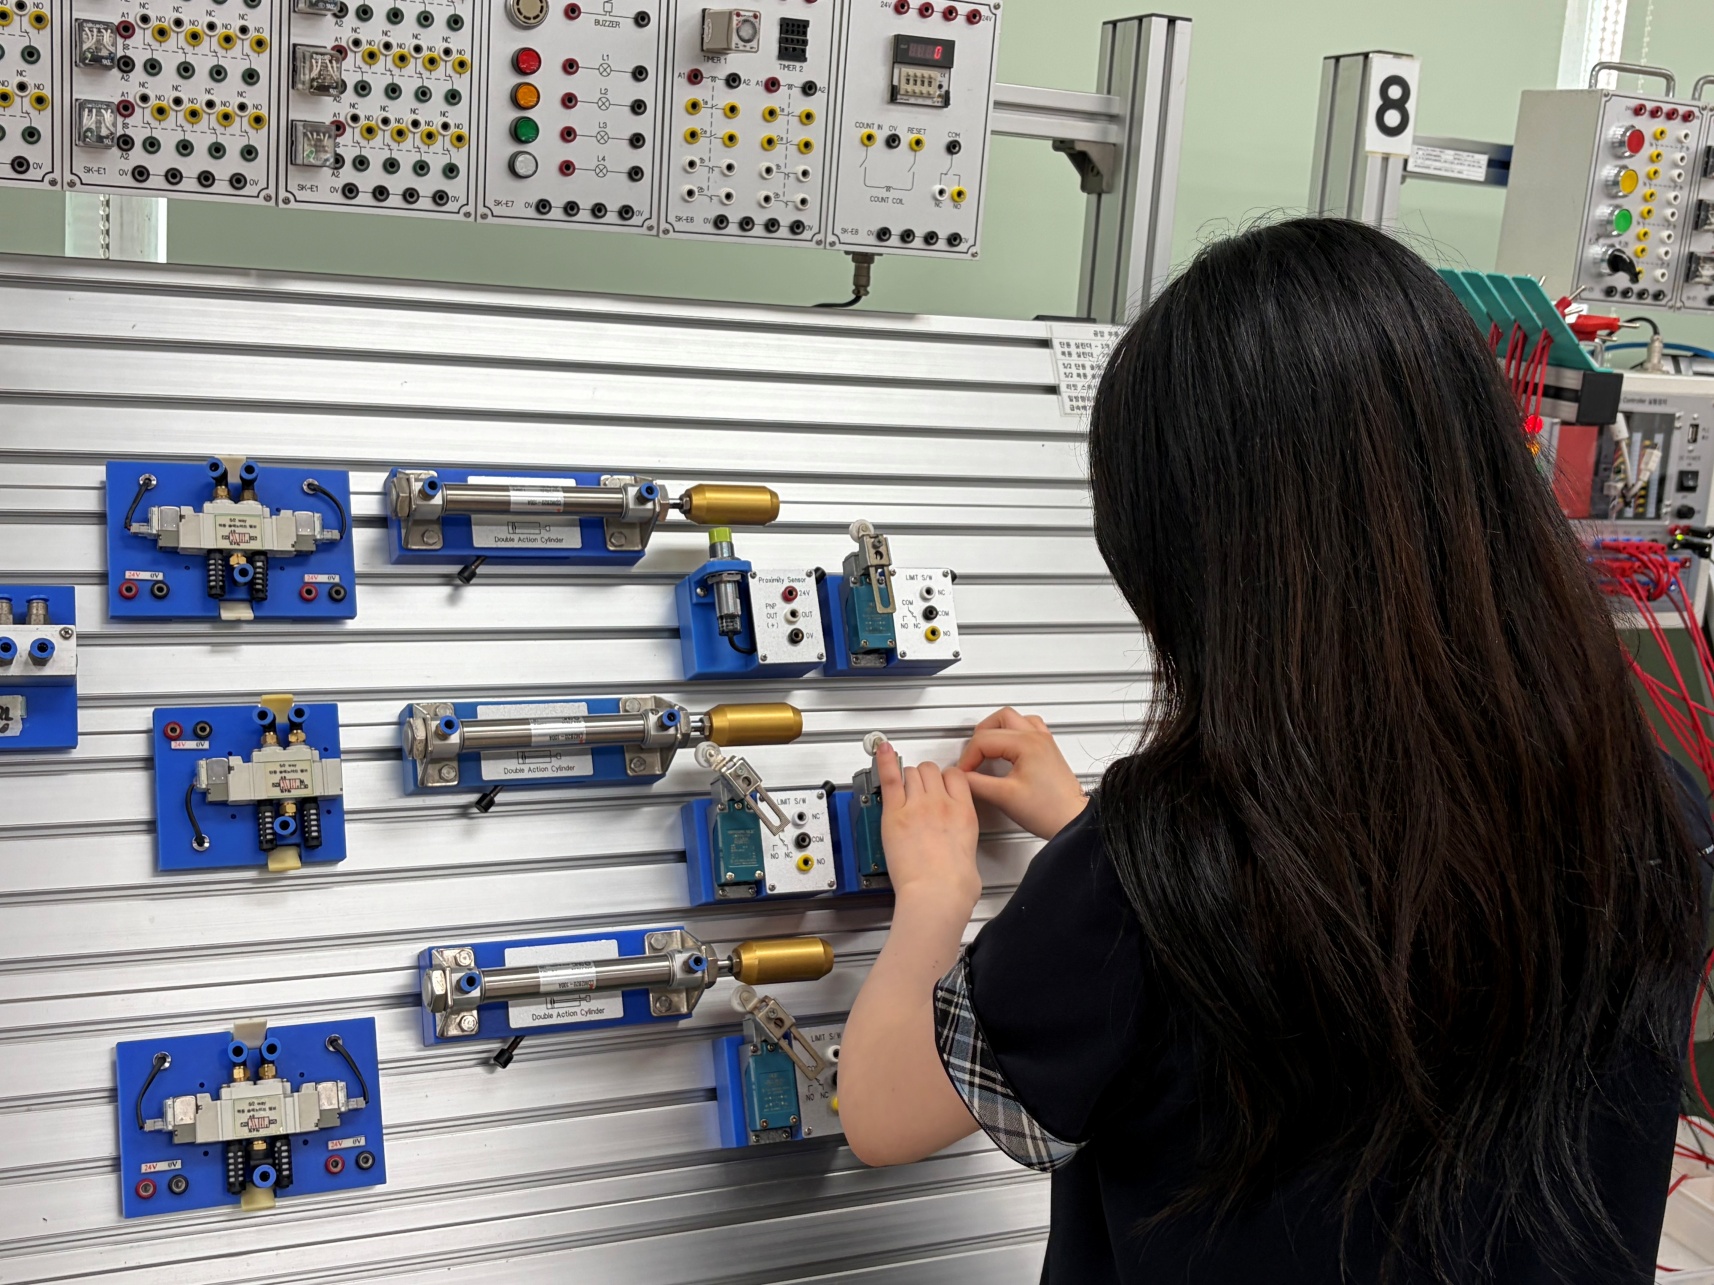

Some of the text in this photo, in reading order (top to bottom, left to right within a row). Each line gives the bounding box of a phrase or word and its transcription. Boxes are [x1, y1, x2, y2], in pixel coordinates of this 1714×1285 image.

[139, 2, 149, 10] NC
[880, 1, 892, 9] 24V
[121, 12, 130, 20] A1
[239, 13, 248, 21] NC
[189, 19, 199, 27] NO
[594, 19, 621, 29] BUZZER
[442, 36, 451, 44] NC
[703, 55, 722, 63] TIMER
[779, 64, 797, 72] TIMER
[16, 69, 27, 77] NC
[139, 81, 149, 89] NC
[742, 78, 751, 86] A2
[34, 83, 45, 91] NO
[121, 91, 129, 99] A1
[155, 94, 165, 102] NO
[350, 102, 359, 110] NC
[380, 105, 389, 113] NC
[1375, 74, 1411, 138] 8
[855, 121, 883, 131] COUNT IN
[907, 127, 927, 135] RESET
[947, 131, 961, 139] COM
[597, 155, 606, 163] L4
[83, 166, 107, 175] SK-E1
[331, 170, 341, 178] A2
[297, 183, 319, 193] SK-E1
[493, 199, 515, 208] SK-E7
[869, 195, 905, 206] COUNT COIL
[953, 202, 962, 210] NO
[494, 535, 564, 546] Double Action Cylinder
[127, 571, 141, 579] 24V
[305, 574, 319, 582] 24V
[905, 574, 933, 582] LIMIT S/W
[758, 576, 807, 586] Proximity Sensor
[799, 589, 811, 597] 24V
[765, 602, 777, 610] PNP
[766, 612, 778, 620] OUT
[801, 611, 813, 619] OUT
[938, 610, 950, 618] COM
[900, 622, 909, 630] NO
[913, 622, 921, 630] NC
[503, 763, 576, 775] Double Action Cylinder
[776, 797, 807, 806] LIMIT S/W
[811, 835, 824, 843] COM
[770, 852, 779, 860] NO
[531, 1007, 605, 1021] Double Action Cylinder
[810, 1033, 826, 1043] LIMIT
[805, 1094, 815, 1102] NO
[820, 1092, 829, 1100] NC
[144, 1163, 157, 1171] 24V
